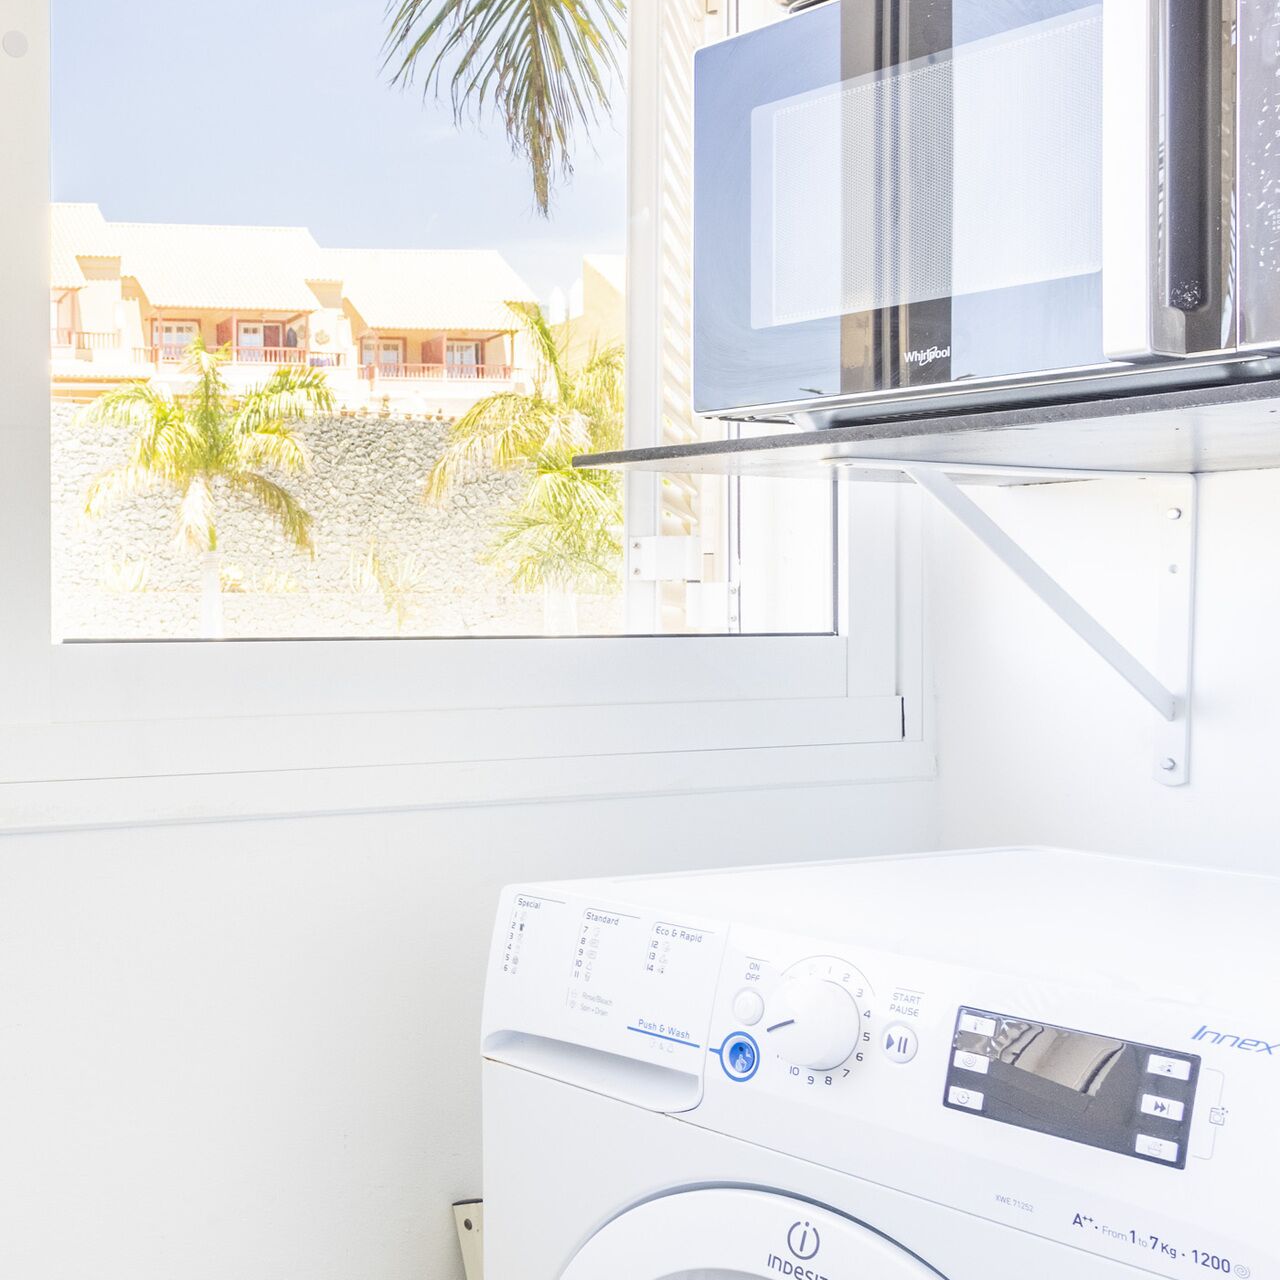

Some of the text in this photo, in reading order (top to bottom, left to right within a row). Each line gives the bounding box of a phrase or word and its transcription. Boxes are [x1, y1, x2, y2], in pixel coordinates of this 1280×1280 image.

[904, 346, 950, 365] Whirlpool
[517, 897, 541, 909] Special
[586, 911, 619, 926] Standard
[655, 926, 703, 943] Eco & Rapid
[651, 940, 659, 949] 12
[648, 952, 656, 960] 13
[646, 964, 654, 972] 14
[749, 962, 761, 972] ON
[745, 972, 761, 982] OFF
[842, 973, 851, 982] 2
[855, 988, 864, 998] 3
[892, 992, 922, 1006] START
[863, 1009, 872, 1019] 4
[889, 1004, 920, 1018] PAUSE
[638, 1018, 690, 1040] Push & Wash
[862, 1032, 871, 1042] 5
[1191, 1025, 1280, 1055] Innex
[855, 1052, 864, 1062] 6
[789, 1065, 800, 1076] 10
[842, 1068, 851, 1079] 7
[807, 1075, 815, 1086] 9
[824, 1075, 833, 1086] 8
[1102, 1225, 1128, 1241] From
[1129, 1230, 1136, 1244] 1
[1138, 1237, 1148, 1248] to
[1149, 1236, 1159, 1250] 7
[1160, 1243, 1177, 1259] Kg
[1191, 1249, 1231, 1273] 1200
